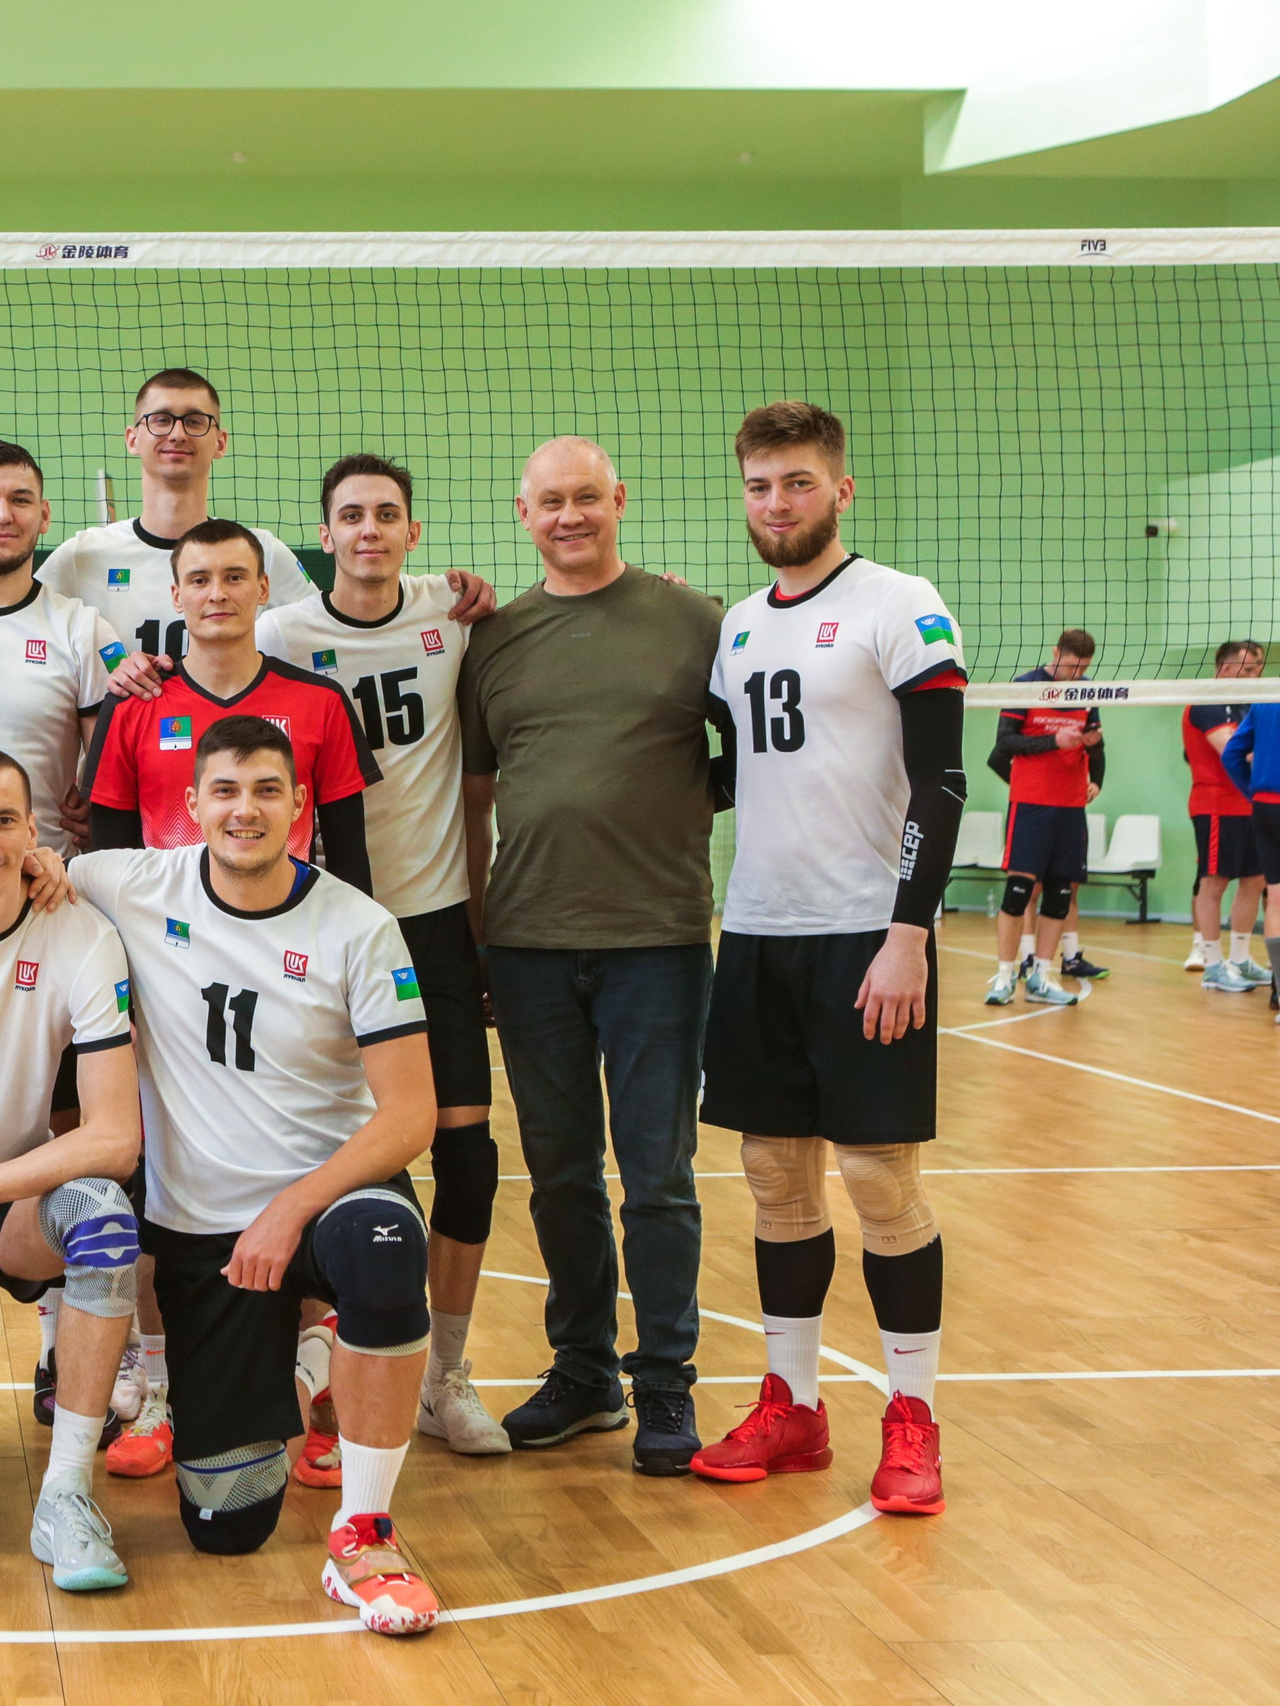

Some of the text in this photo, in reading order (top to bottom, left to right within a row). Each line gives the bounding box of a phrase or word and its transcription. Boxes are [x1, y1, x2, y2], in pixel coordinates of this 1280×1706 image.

[61, 244, 129, 259] 金陵体育
[1081, 239, 1107, 251] FIVB
[422, 631, 442, 649] LUK
[818, 624, 837, 641] LUK
[27, 641, 46, 659] LUK
[352, 666, 425, 751] 15
[744, 668, 805, 754] 13
[285, 952, 307, 974] LUK
[19, 963, 37, 982] LUK
[200, 981, 259, 1072] 11
